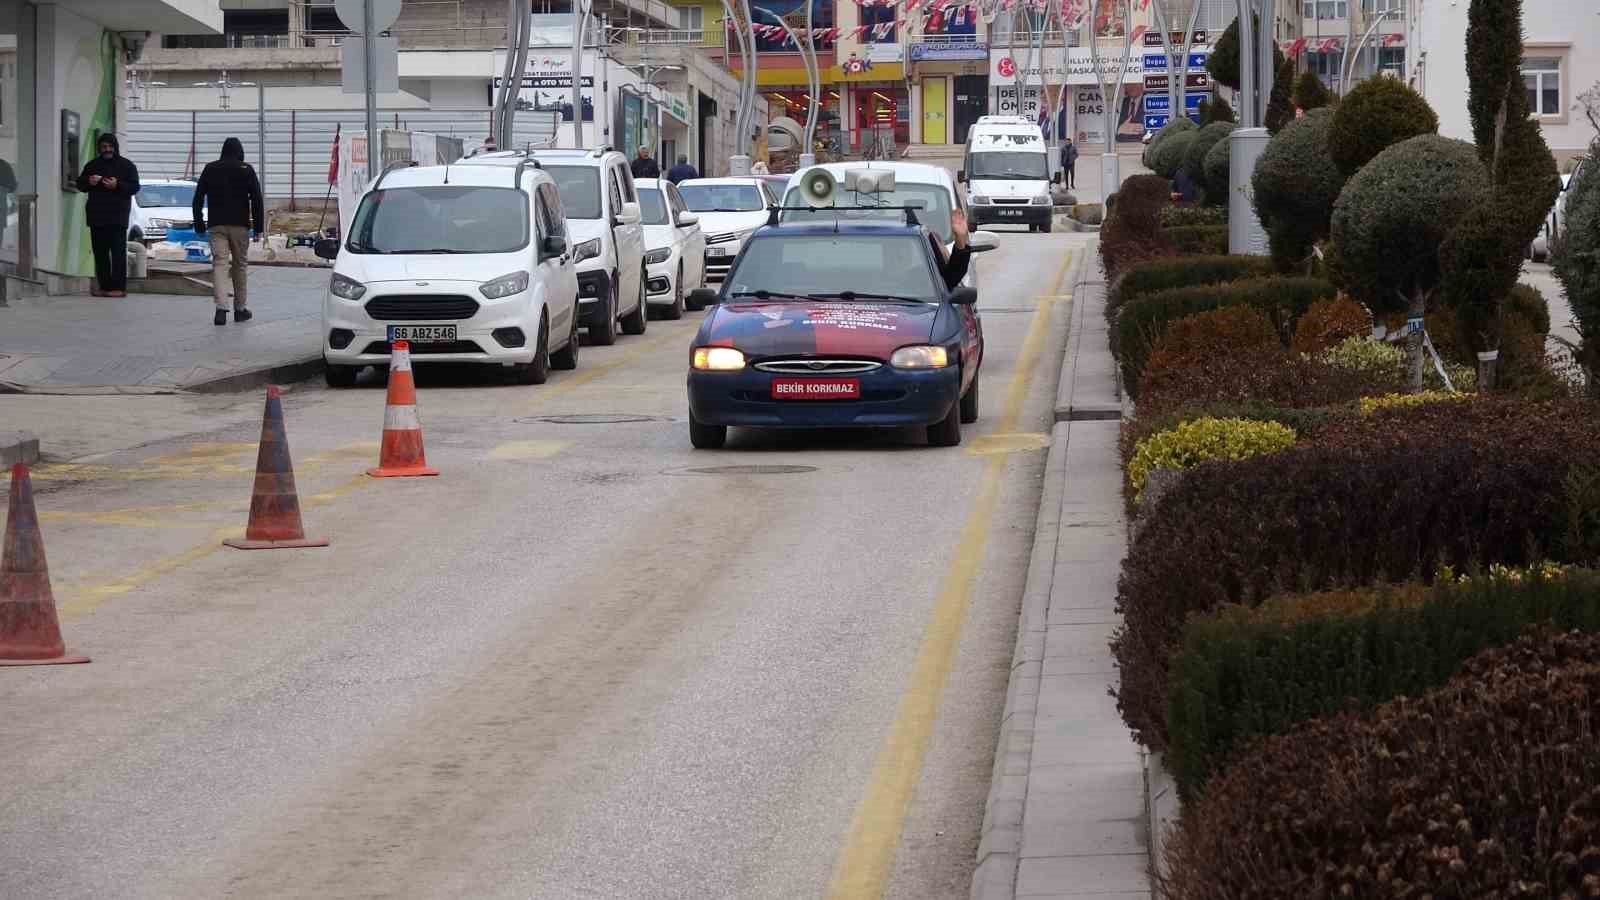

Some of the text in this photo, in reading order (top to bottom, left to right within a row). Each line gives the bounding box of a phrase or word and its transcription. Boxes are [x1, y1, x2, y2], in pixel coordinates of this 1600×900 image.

[1001, 90, 1037, 98] DEER
[395, 327, 455, 338] 66 ABZ 546
[776, 381, 854, 393] BEKİR KORKMAZ
